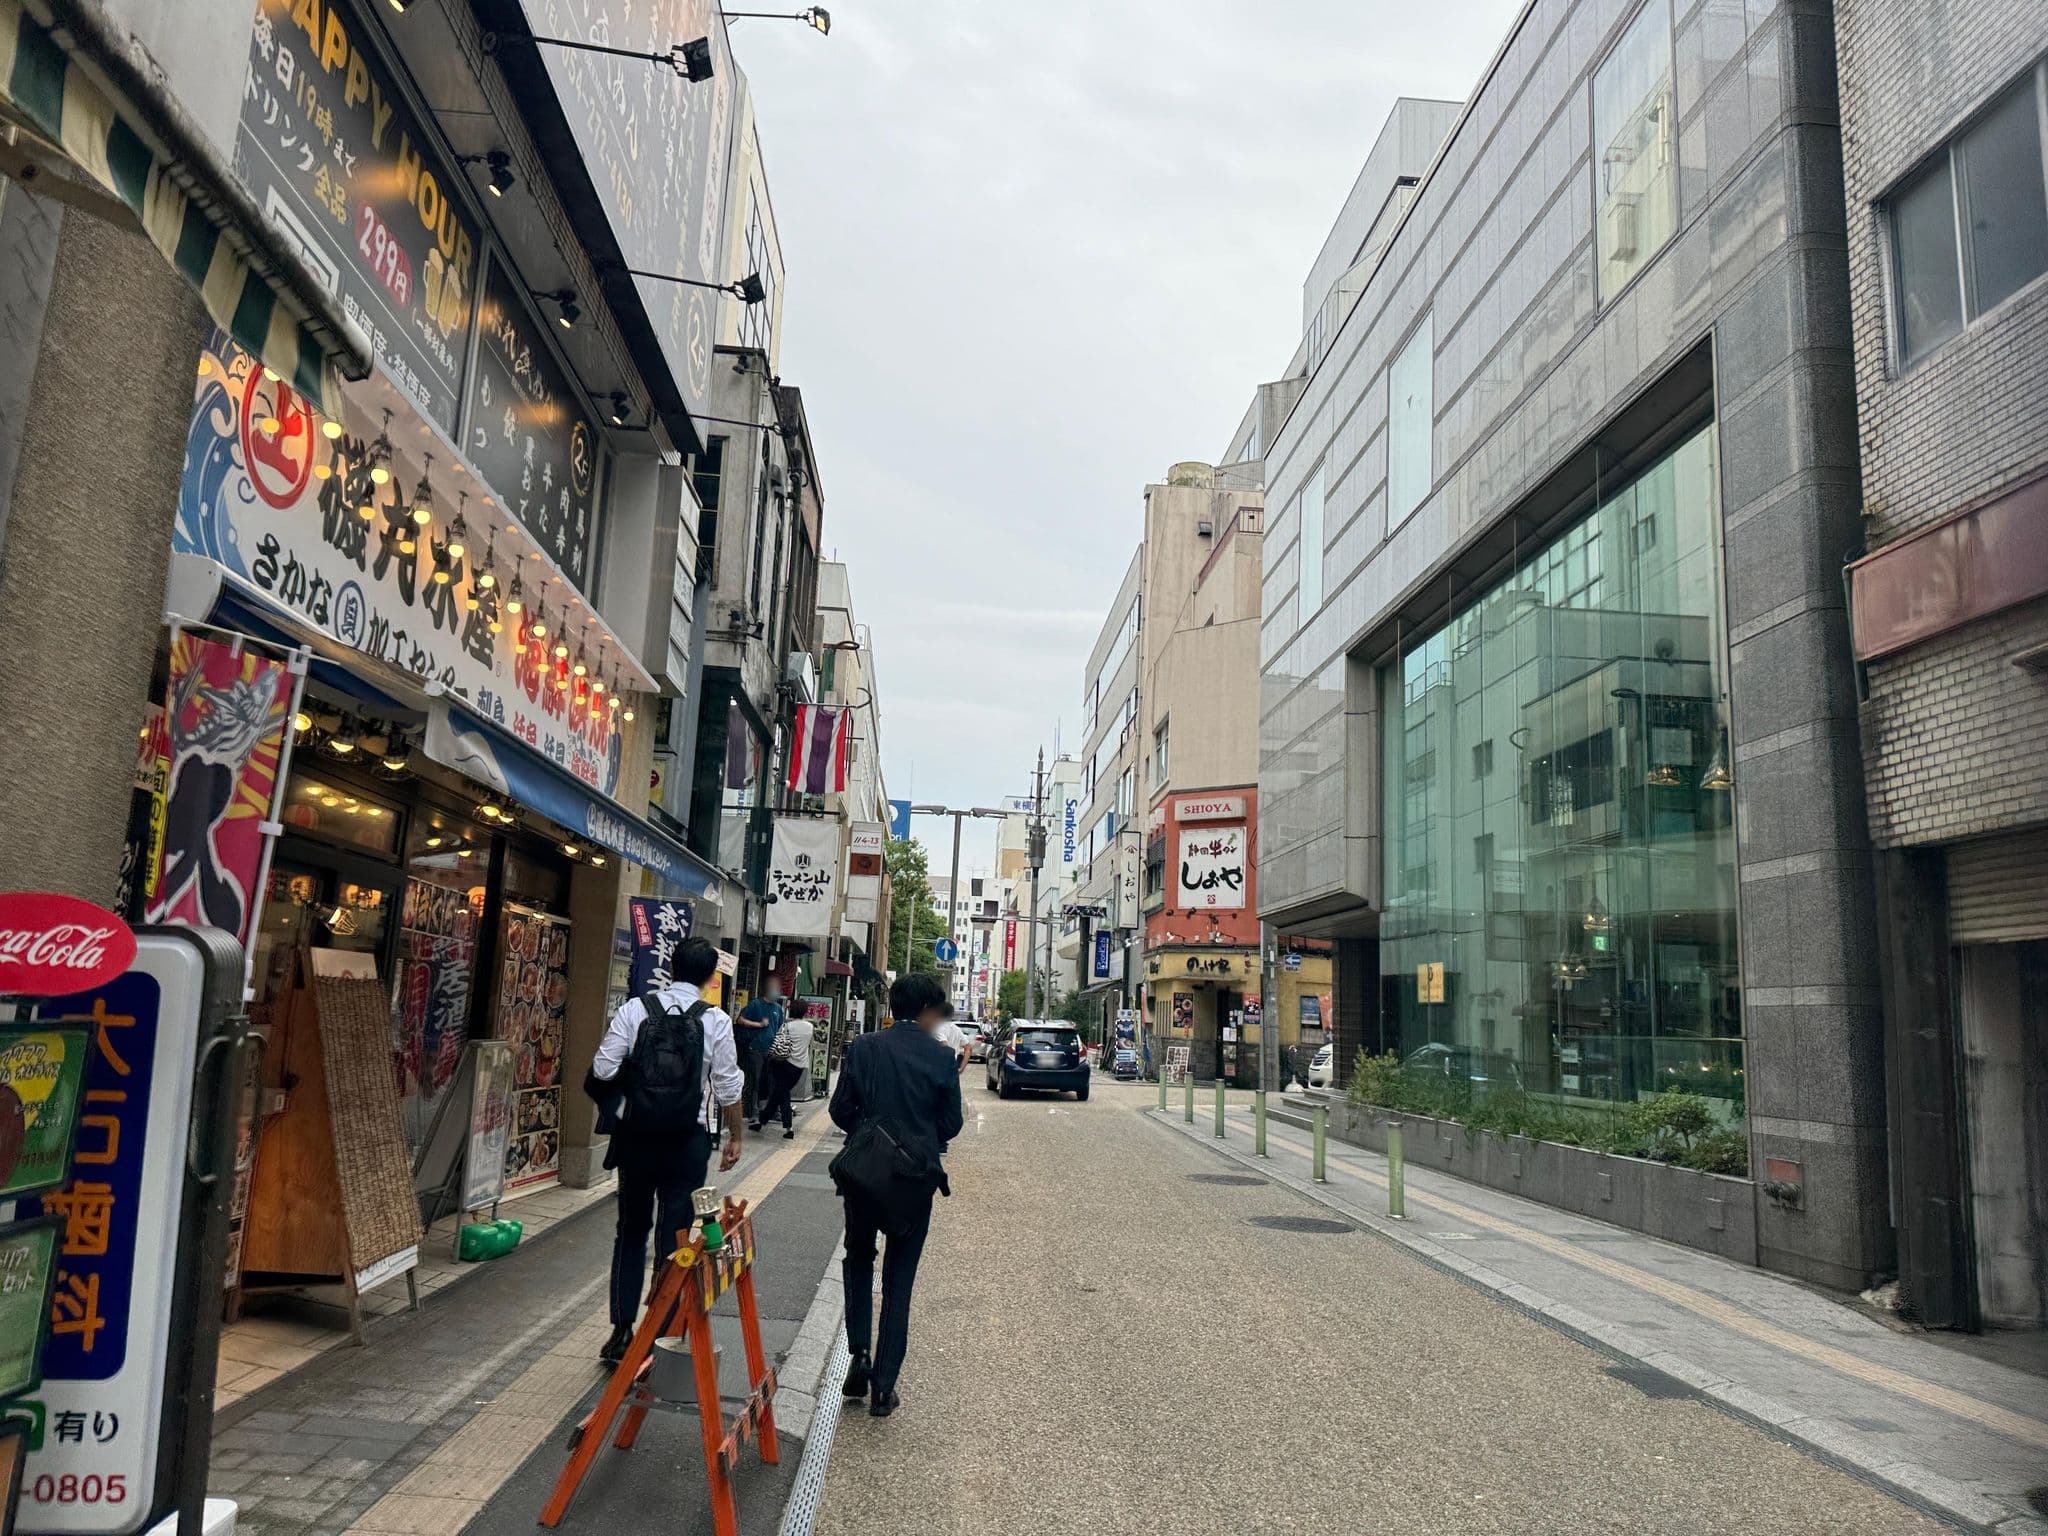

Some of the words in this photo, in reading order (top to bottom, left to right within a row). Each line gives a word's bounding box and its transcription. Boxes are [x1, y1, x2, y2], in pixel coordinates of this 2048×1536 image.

[279, 0, 392, 150] APPY
[399, 131, 473, 290] HOUR
[359, 206, 408, 304] 299円
[317, 432, 502, 671] 磯丸水産
[1184, 803, 1232, 815] SHIOYA
[1063, 799, 1078, 863] Sankosha
[773, 869, 831, 885] ラーメン山
[778, 882, 824, 901] なぜか
[1124, 860, 1137, 903] しおや
[1182, 861, 1243, 891] しおや
[53, 1410, 120, 1445] 有り
[21, 1473, 127, 1505] -0805
